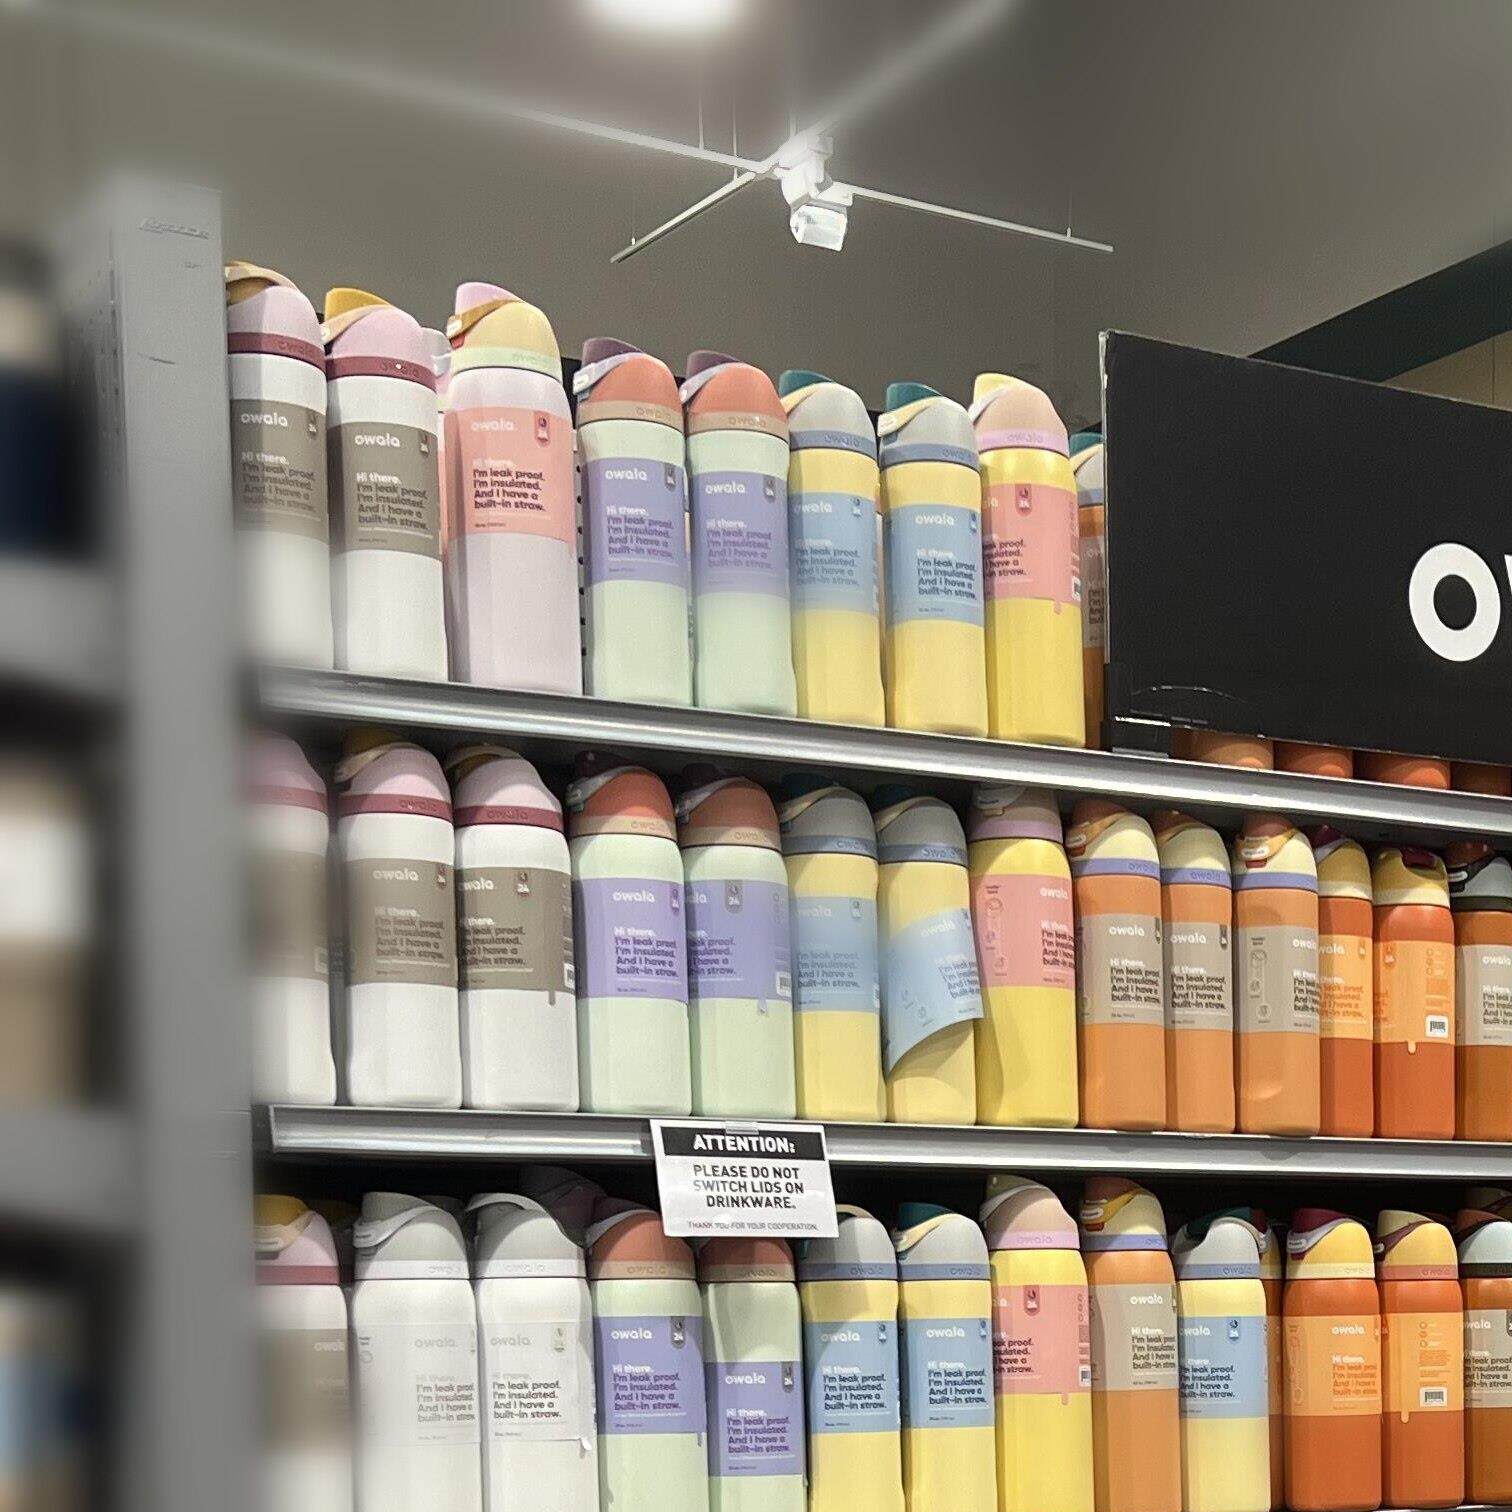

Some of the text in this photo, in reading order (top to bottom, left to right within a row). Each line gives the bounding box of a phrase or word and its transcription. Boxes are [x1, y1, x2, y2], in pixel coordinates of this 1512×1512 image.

[471, 419, 514, 432] owala
[355, 433, 400, 447] owala
[474, 468, 545, 481] I'm leak proof.
[474, 479, 541, 490] I'm insulated.
[474, 490, 493, 499] And
[502, 491, 528, 499] have
[474, 500, 545, 511] built-in straw.
[612, 890, 655, 902] owala
[694, 1135, 796, 1153] ATTENTION:
[693, 1164, 799, 1179] PLEASE DO NOT
[693, 1180, 804, 1193] SWITCH LIDS ON
[706, 1196, 796, 1209] DRINKWARE.
[611, 1328, 652, 1340] owala
[673, 1333, 684, 1341] 24
[820, 1331, 860, 1342] owala
[927, 1327, 965, 1338] owala
[491, 1337, 531, 1346] owala
[613, 1365, 622, 1373] Hi
[614, 1373, 680, 1383] I'm leak proof.
[614, 1382, 679, 1391] I'm insulated.
[614, 1402, 681, 1411] built-in straw.
